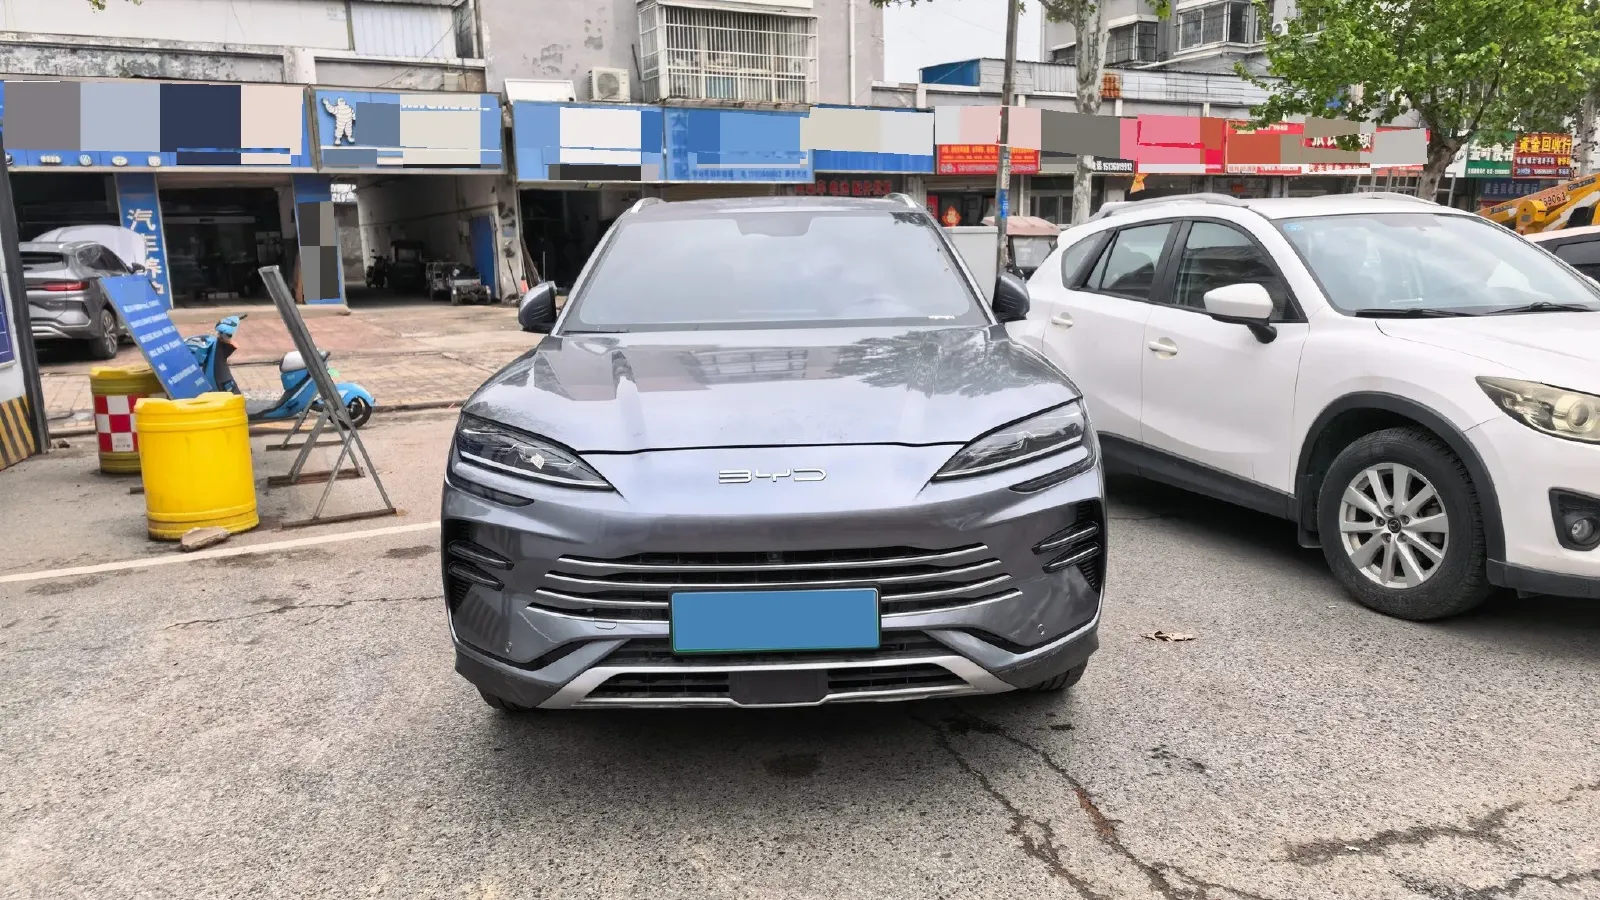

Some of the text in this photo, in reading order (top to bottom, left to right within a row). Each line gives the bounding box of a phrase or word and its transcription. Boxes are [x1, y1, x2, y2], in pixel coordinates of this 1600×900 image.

[1519, 136, 1571, 154] 黄金回收行
[718, 467, 827, 484] BYD
